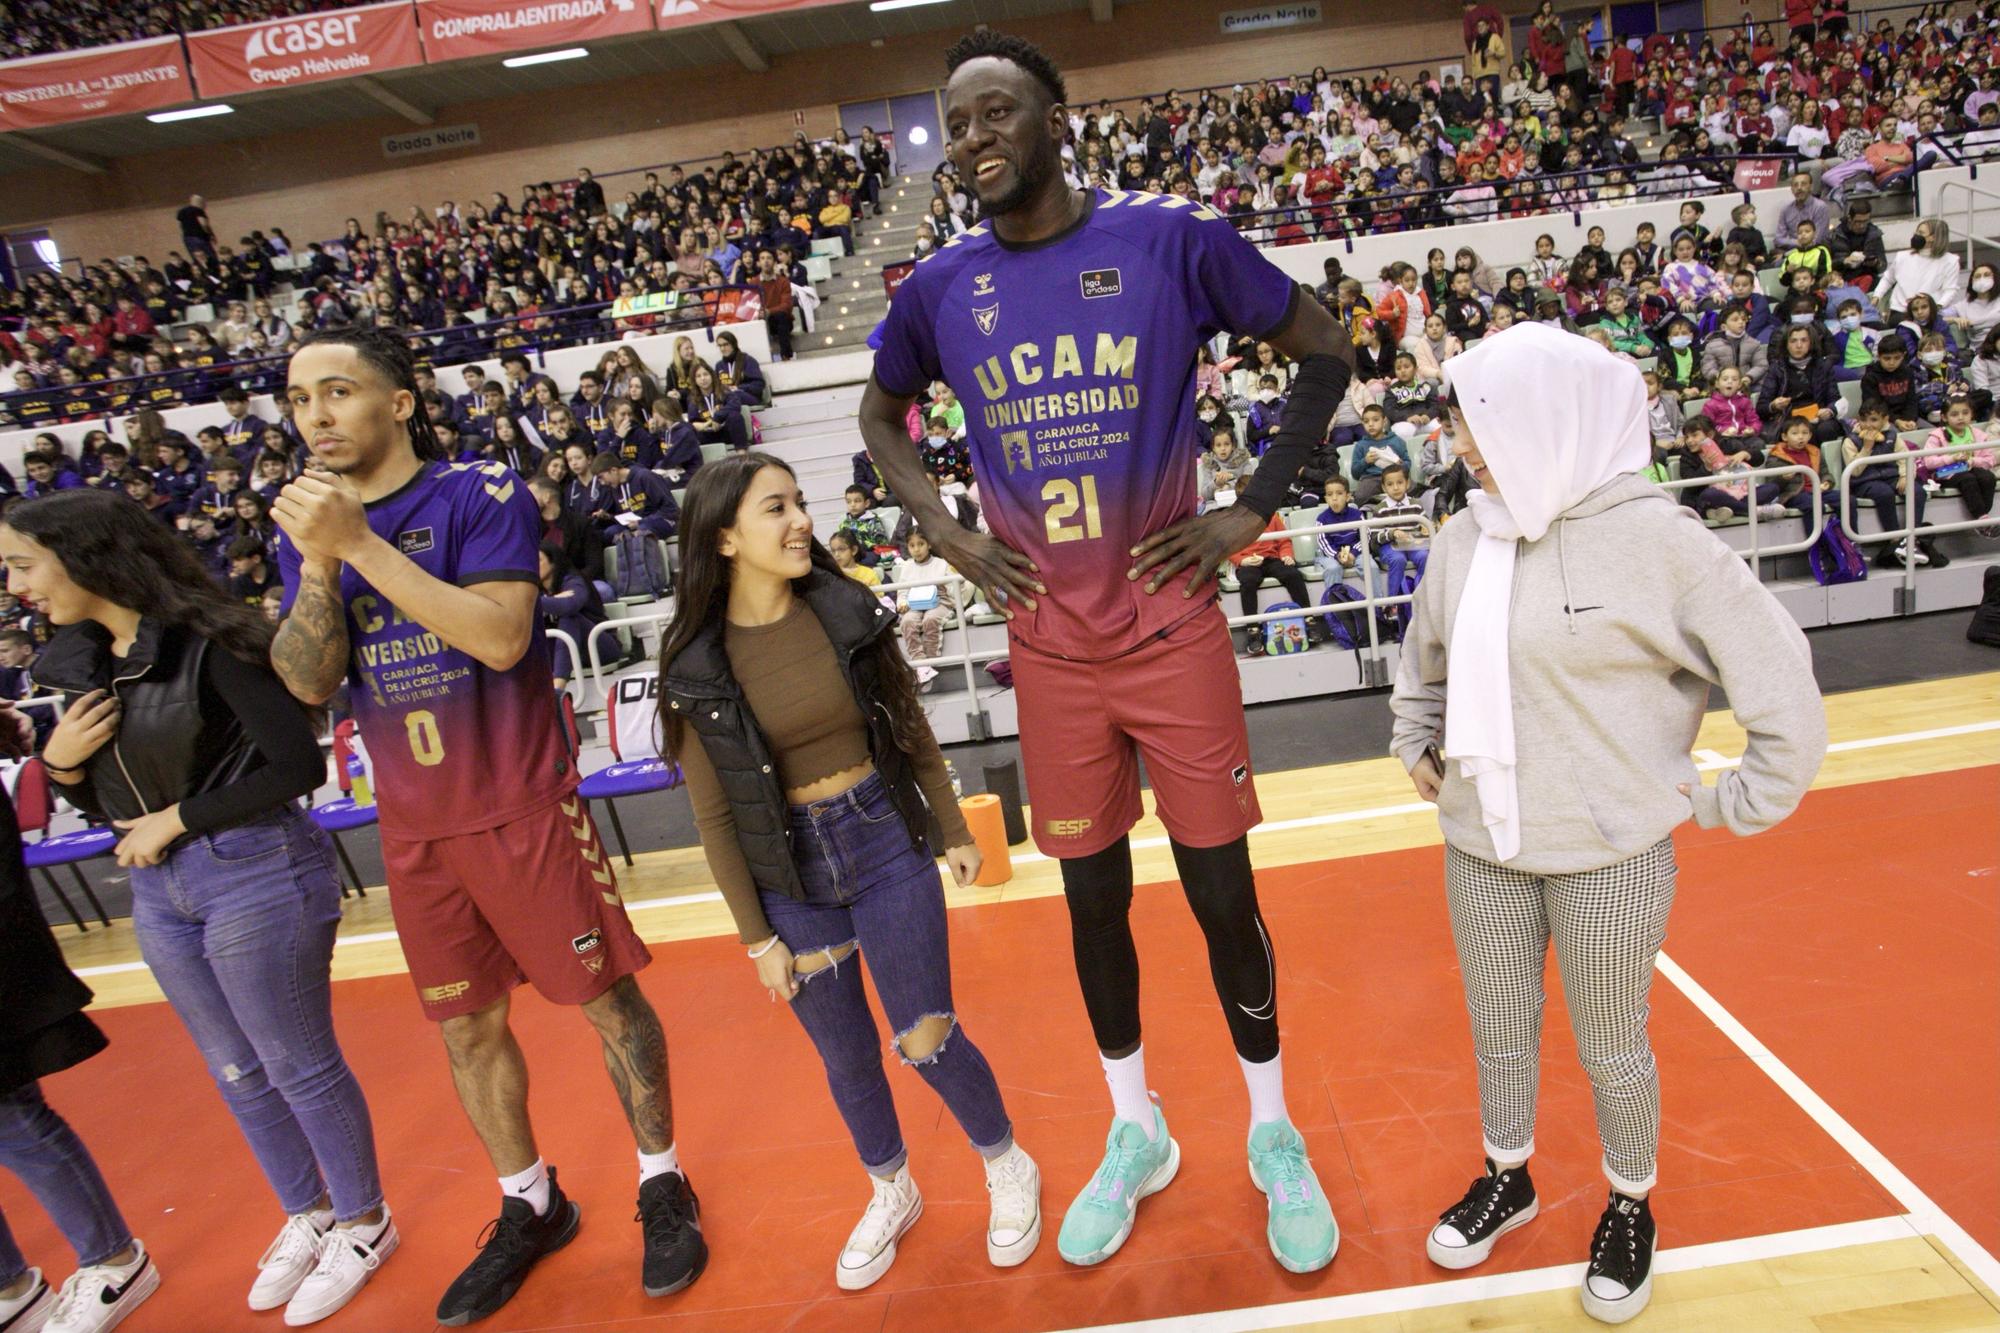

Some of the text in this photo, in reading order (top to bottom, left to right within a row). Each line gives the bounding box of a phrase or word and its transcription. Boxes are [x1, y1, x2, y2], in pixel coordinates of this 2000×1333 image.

[1224, 7, 1316, 27] Grada Norte
[264, 15, 361, 56] caser
[250, 52, 370, 84] Grupo Helvetia
[5, 80, 91, 103] ESTRELLA
[387, 130, 475, 153] Grada Norte
[1086, 285, 1118, 294] endesa
[973, 333, 1138, 401] UCAM
[984, 384, 1139, 429] UNIVERSIDAD
[1036, 422, 1099, 440] CARAVACA
[1037, 431, 1130, 453] DE LA CRUZ 2024
[1039, 449, 1108, 467] AÑO JUBILAR
[1041, 475, 1103, 544] 21
[382, 663, 439, 681] CARAVACA
[385, 666, 470, 693] DE LA CRUZ 2024
[404, 709, 445, 766] 0
[578, 938, 597, 950] acb
